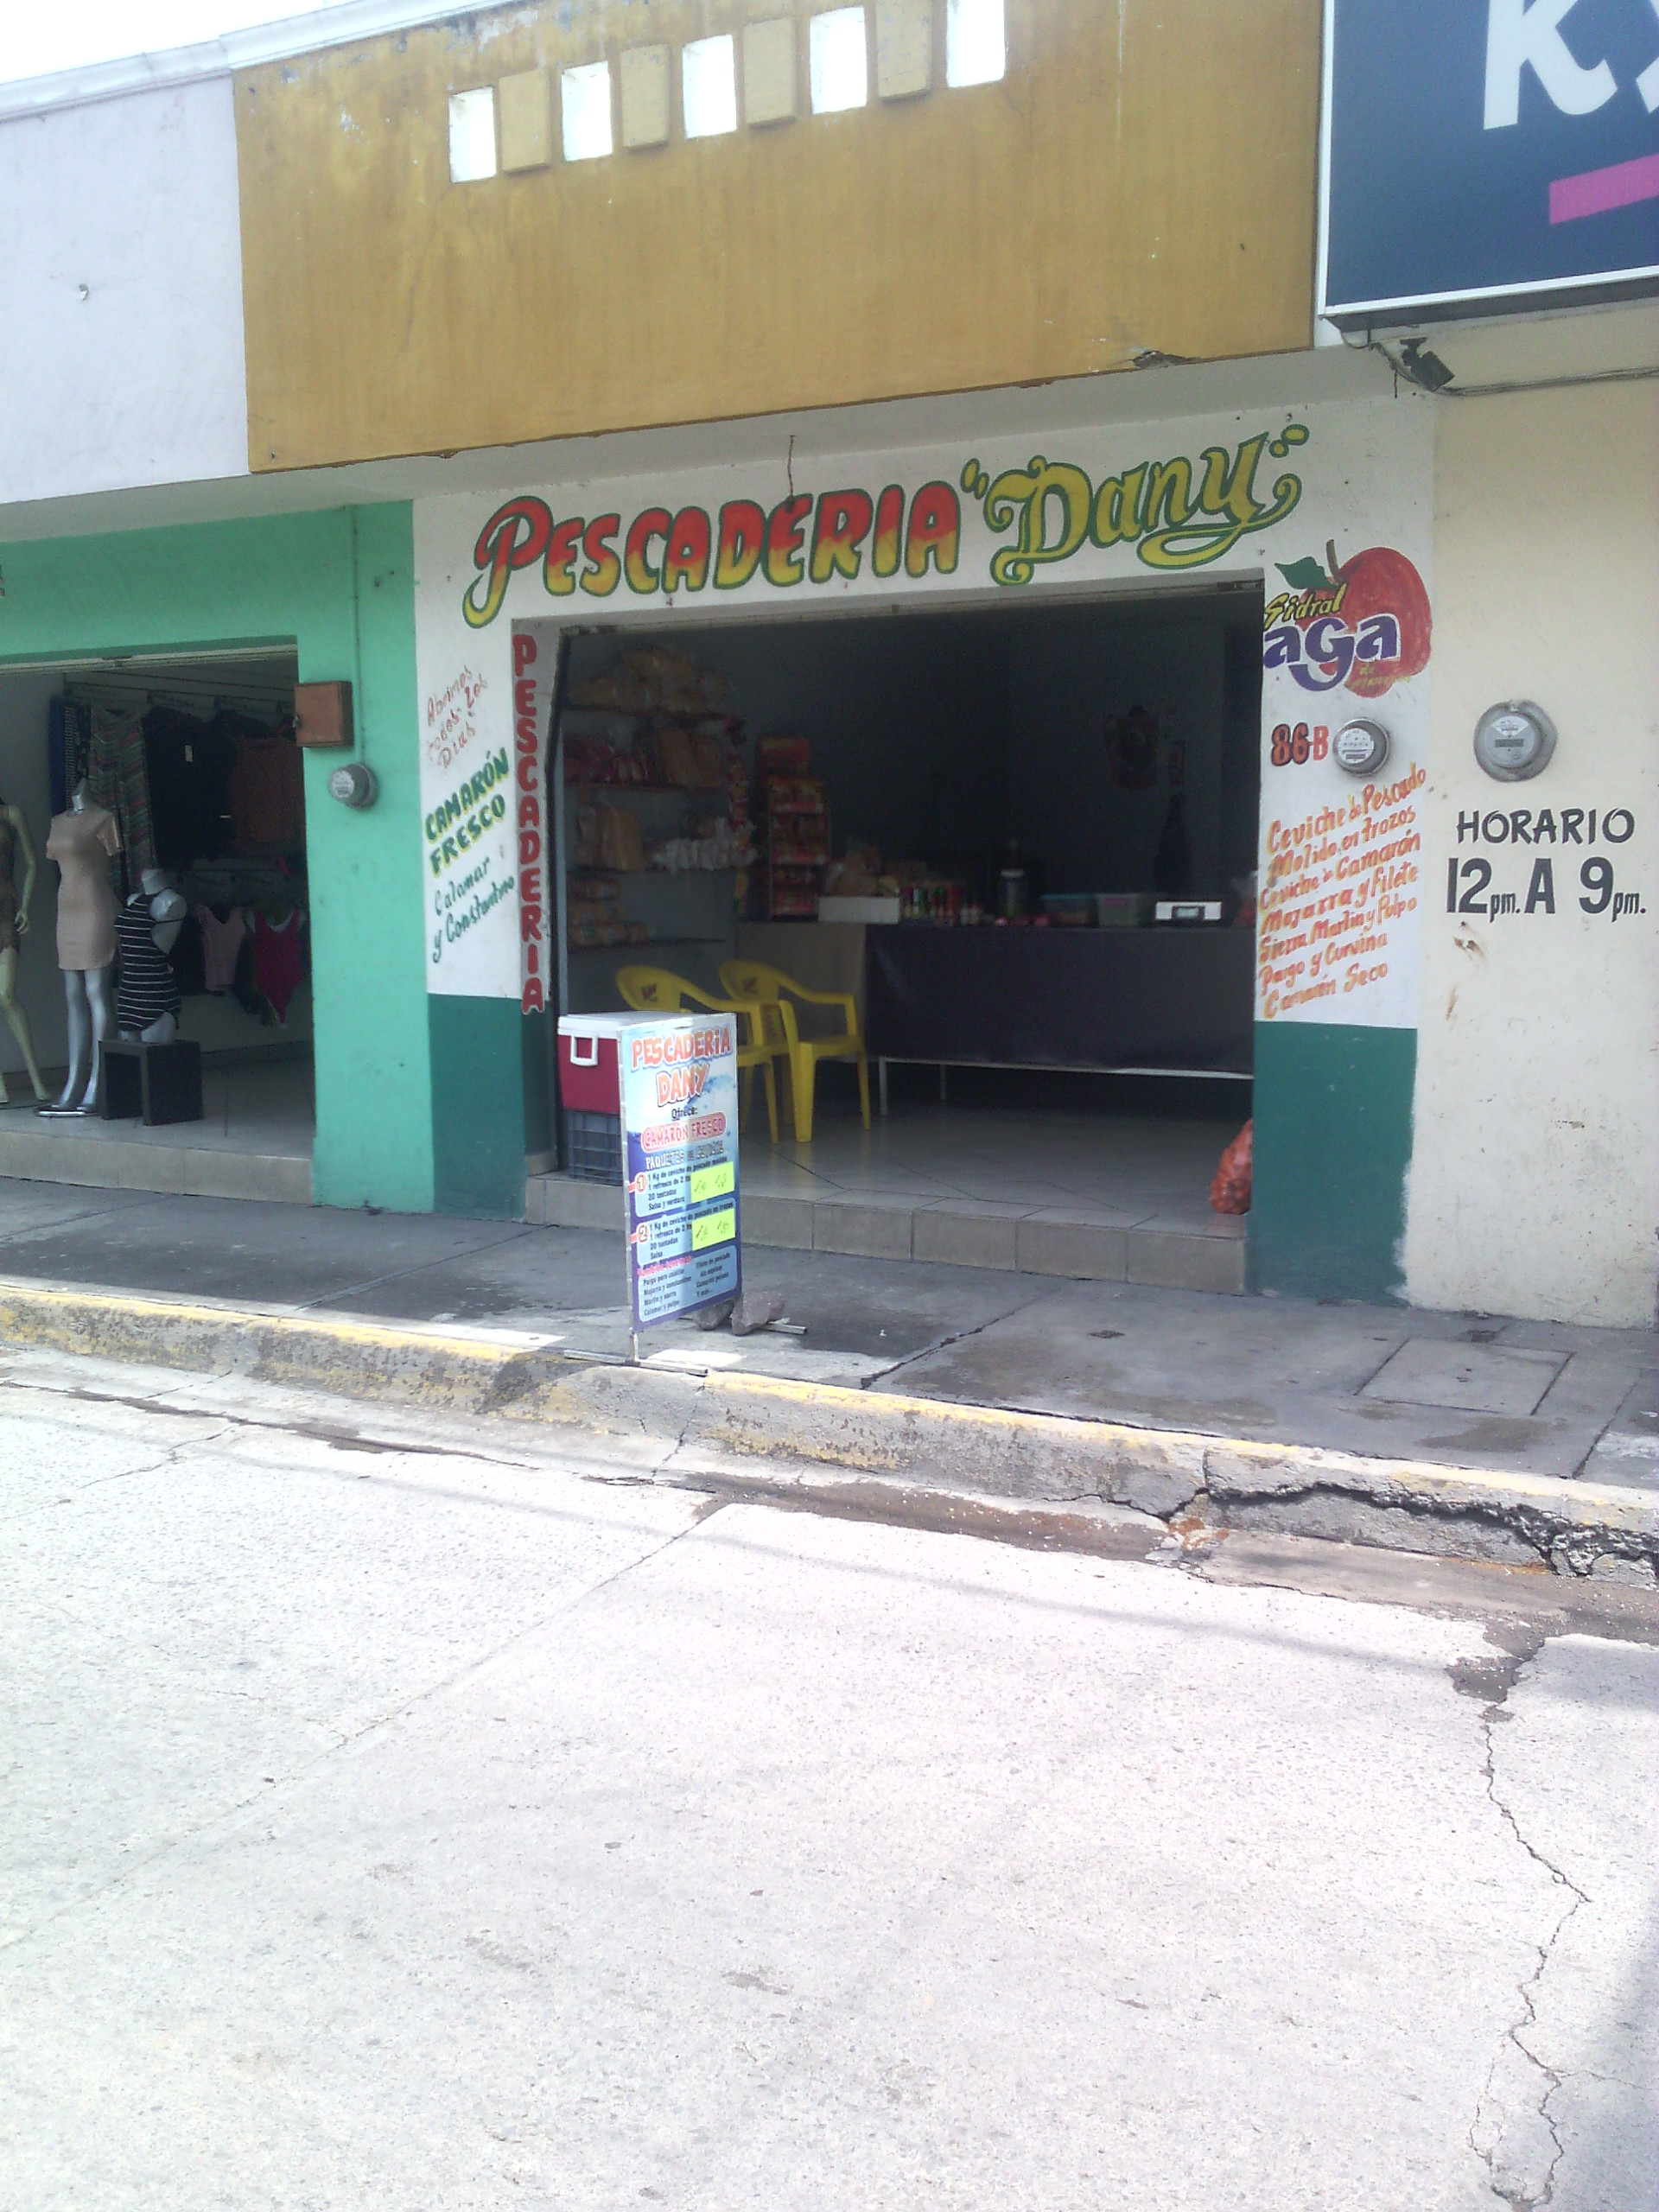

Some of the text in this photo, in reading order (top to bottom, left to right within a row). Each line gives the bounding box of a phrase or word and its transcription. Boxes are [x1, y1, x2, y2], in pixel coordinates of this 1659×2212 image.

[462, 480, 961, 628] PESCADERIA
[1264, 582, 1347, 630] Sidral
[425, 747, 509, 844] CAMARÓN
[512, 634, 544, 1014] PESCADERIA
[1267, 806, 1345, 855] Ceviche
[1362, 760, 1427, 815] Pescado
[1457, 807, 1635, 844] HORARIO
[429, 794, 505, 878] FRESCO
[1268, 805, 1417, 885] Molido en trozos
[435, 856, 490, 916] Calamar
[1259, 874, 1319, 914] Ceviche
[1334, 829, 1421, 880] Camarón
[1260, 861, 1418, 936] Mojarra y Filete
[1524, 858, 1555, 913] A
[1259, 933, 1307, 964] Sierra
[1362, 910, 1375, 932] y
[1377, 893, 1417, 925] Pulpo
[1259, 961, 1305, 997] Pargo
[1310, 952, 1323, 976] y
[1344, 962, 1388, 992] Seco
[657, 1064, 709, 1107] DANY
[691, 1117, 724, 1137] FRESCO
[639, 1225, 647, 1241] 2
